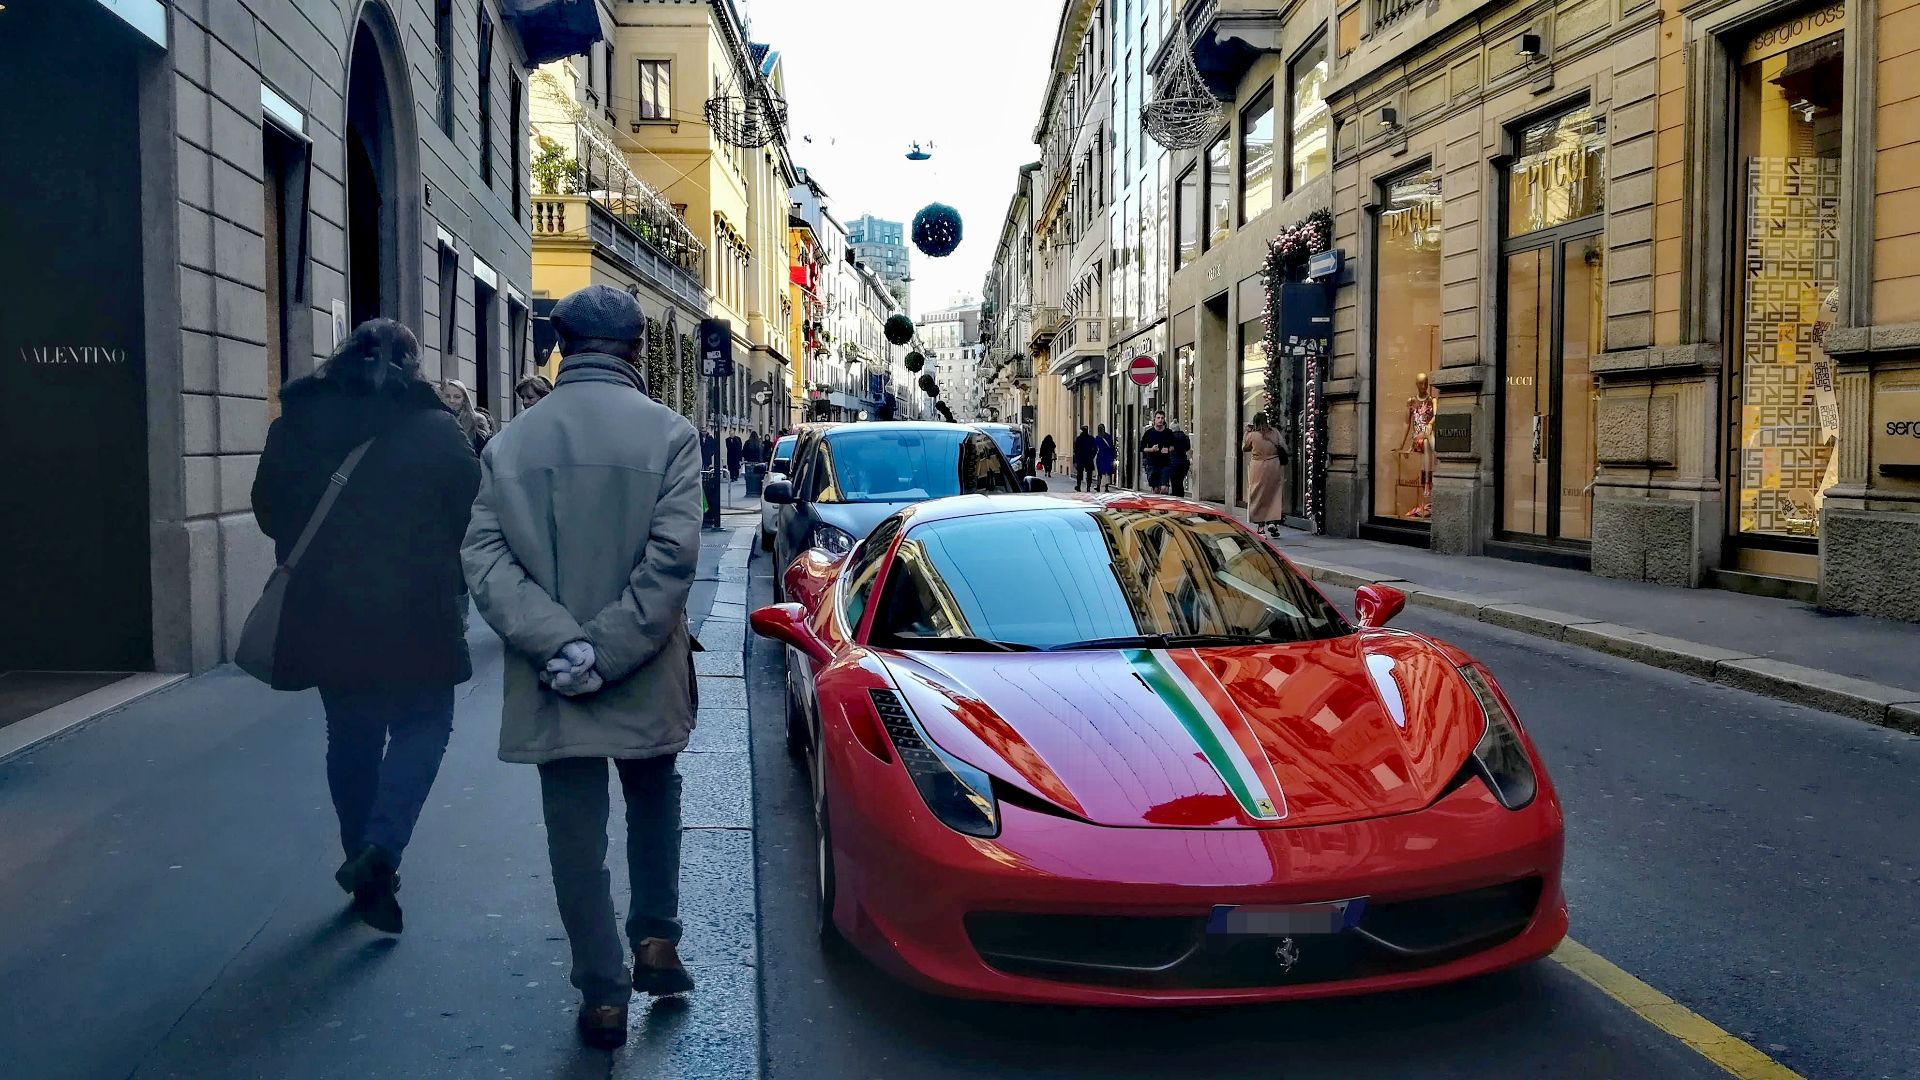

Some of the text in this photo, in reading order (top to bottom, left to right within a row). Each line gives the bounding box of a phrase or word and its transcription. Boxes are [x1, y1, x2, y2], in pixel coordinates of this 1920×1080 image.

[1754, 19, 1803, 50] sergio
[1525, 144, 1589, 197] PUCCI
[1390, 200, 1434, 240] PUCCI
[20, 346, 126, 363] VALENTINO
